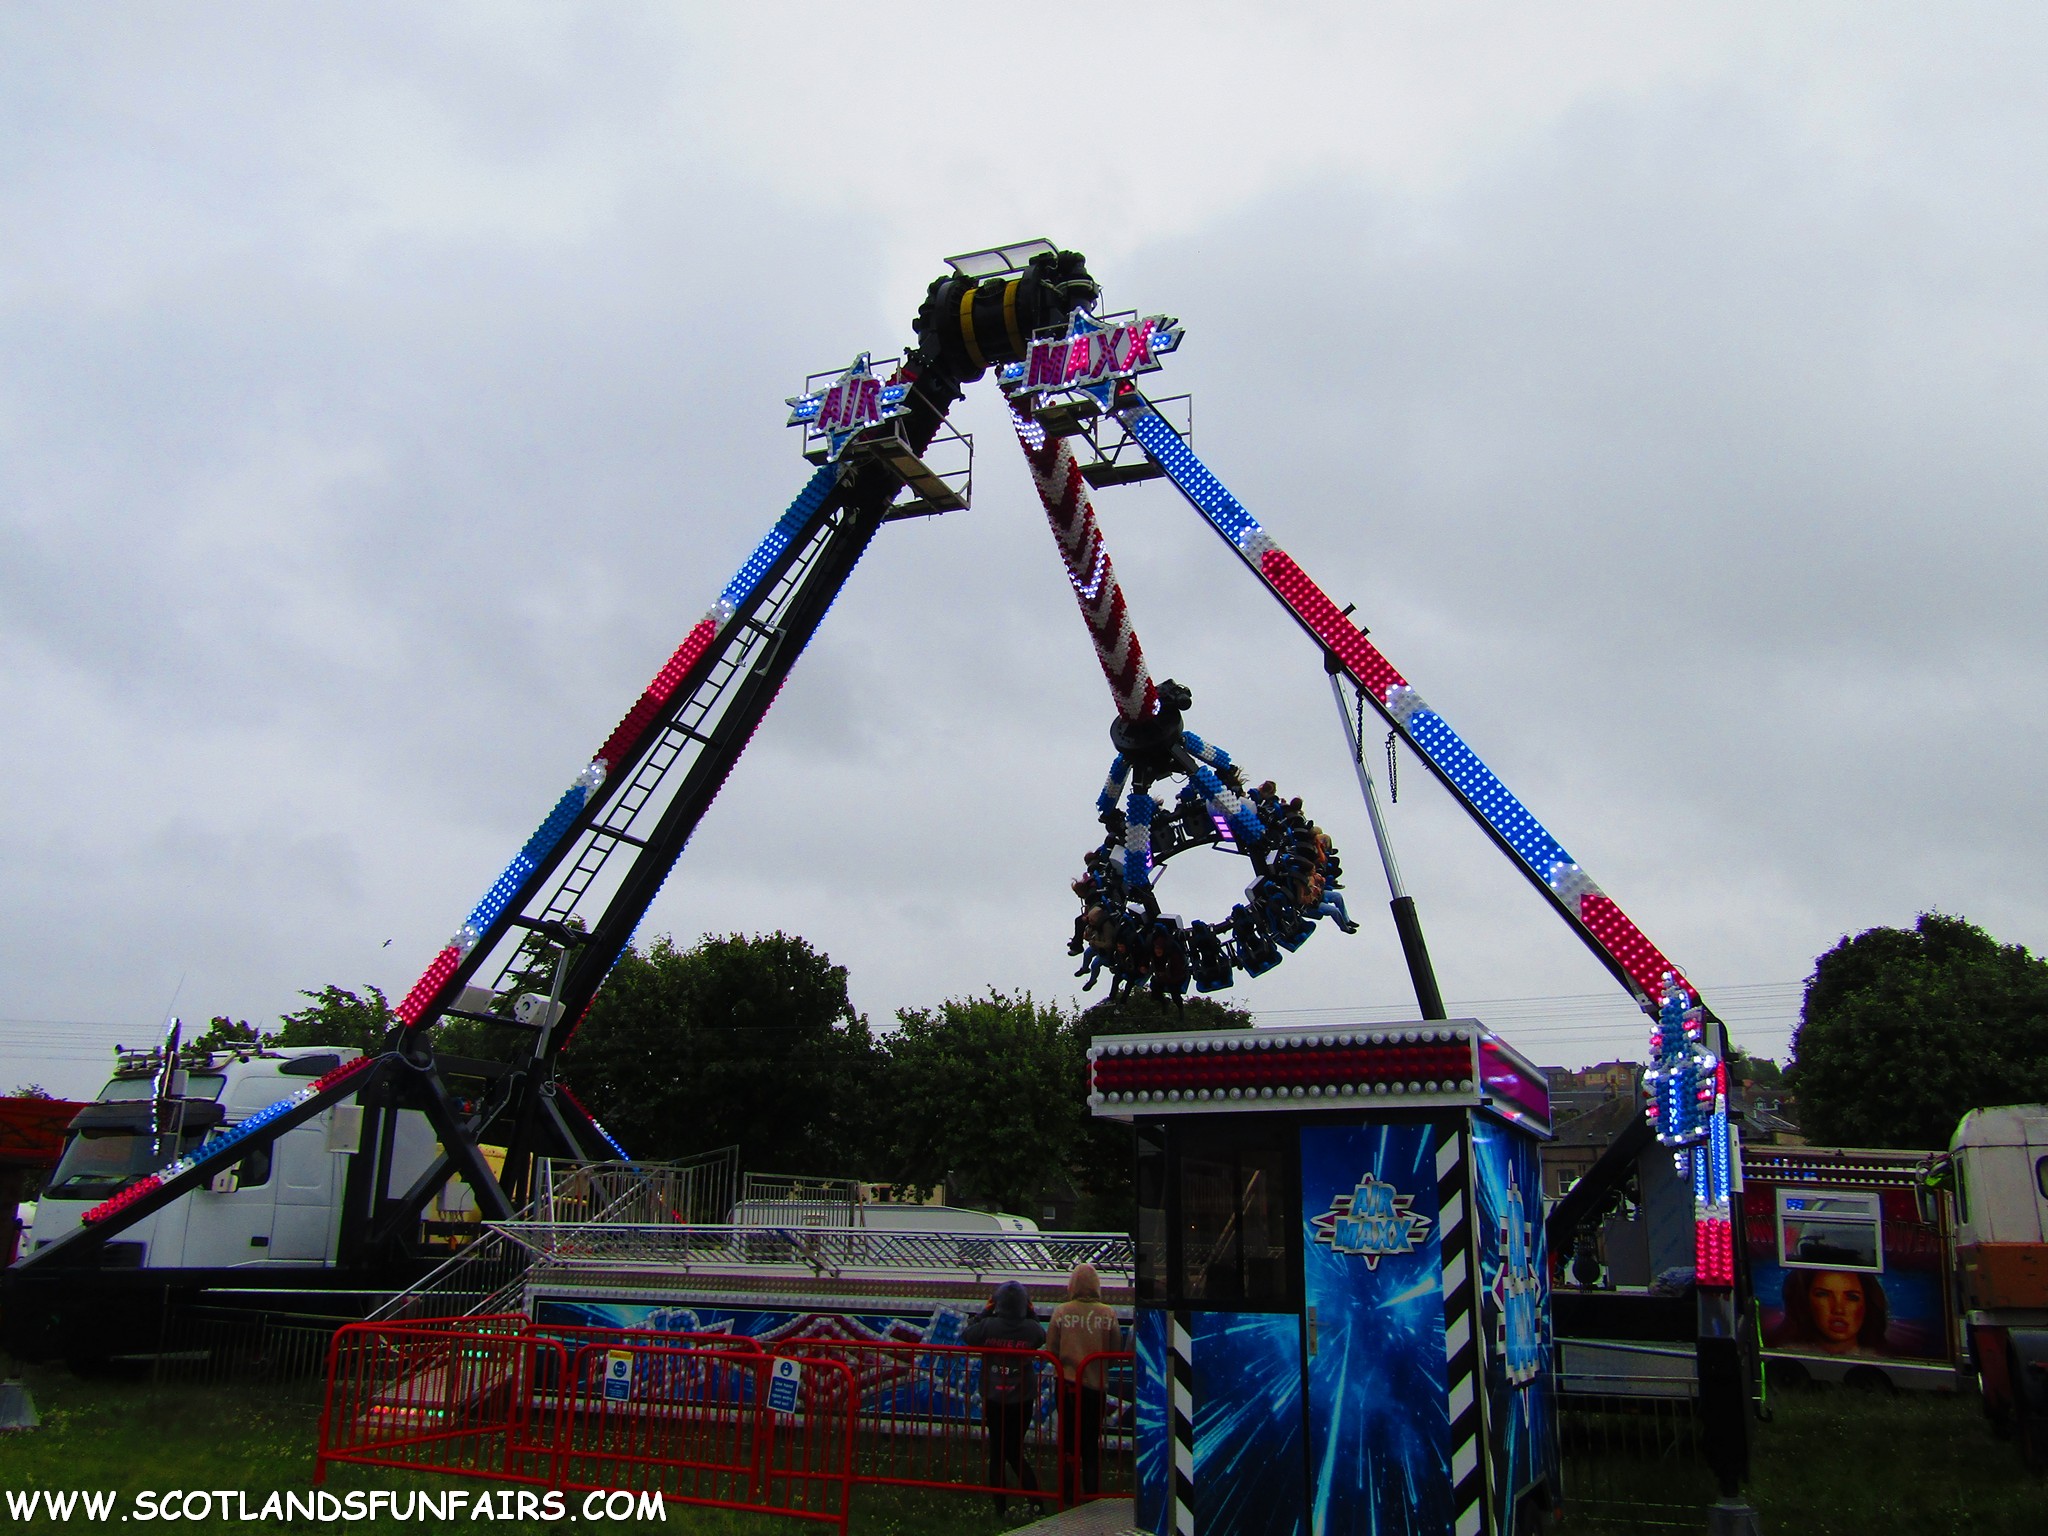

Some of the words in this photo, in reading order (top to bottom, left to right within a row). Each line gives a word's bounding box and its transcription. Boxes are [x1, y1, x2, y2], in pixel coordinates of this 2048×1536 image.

[1026, 318, 1155, 388] MAXX
[818, 378, 880, 430] AIR
[1351, 1185, 1395, 1217] AIR
[1335, 1219, 1411, 1250] MAXX
